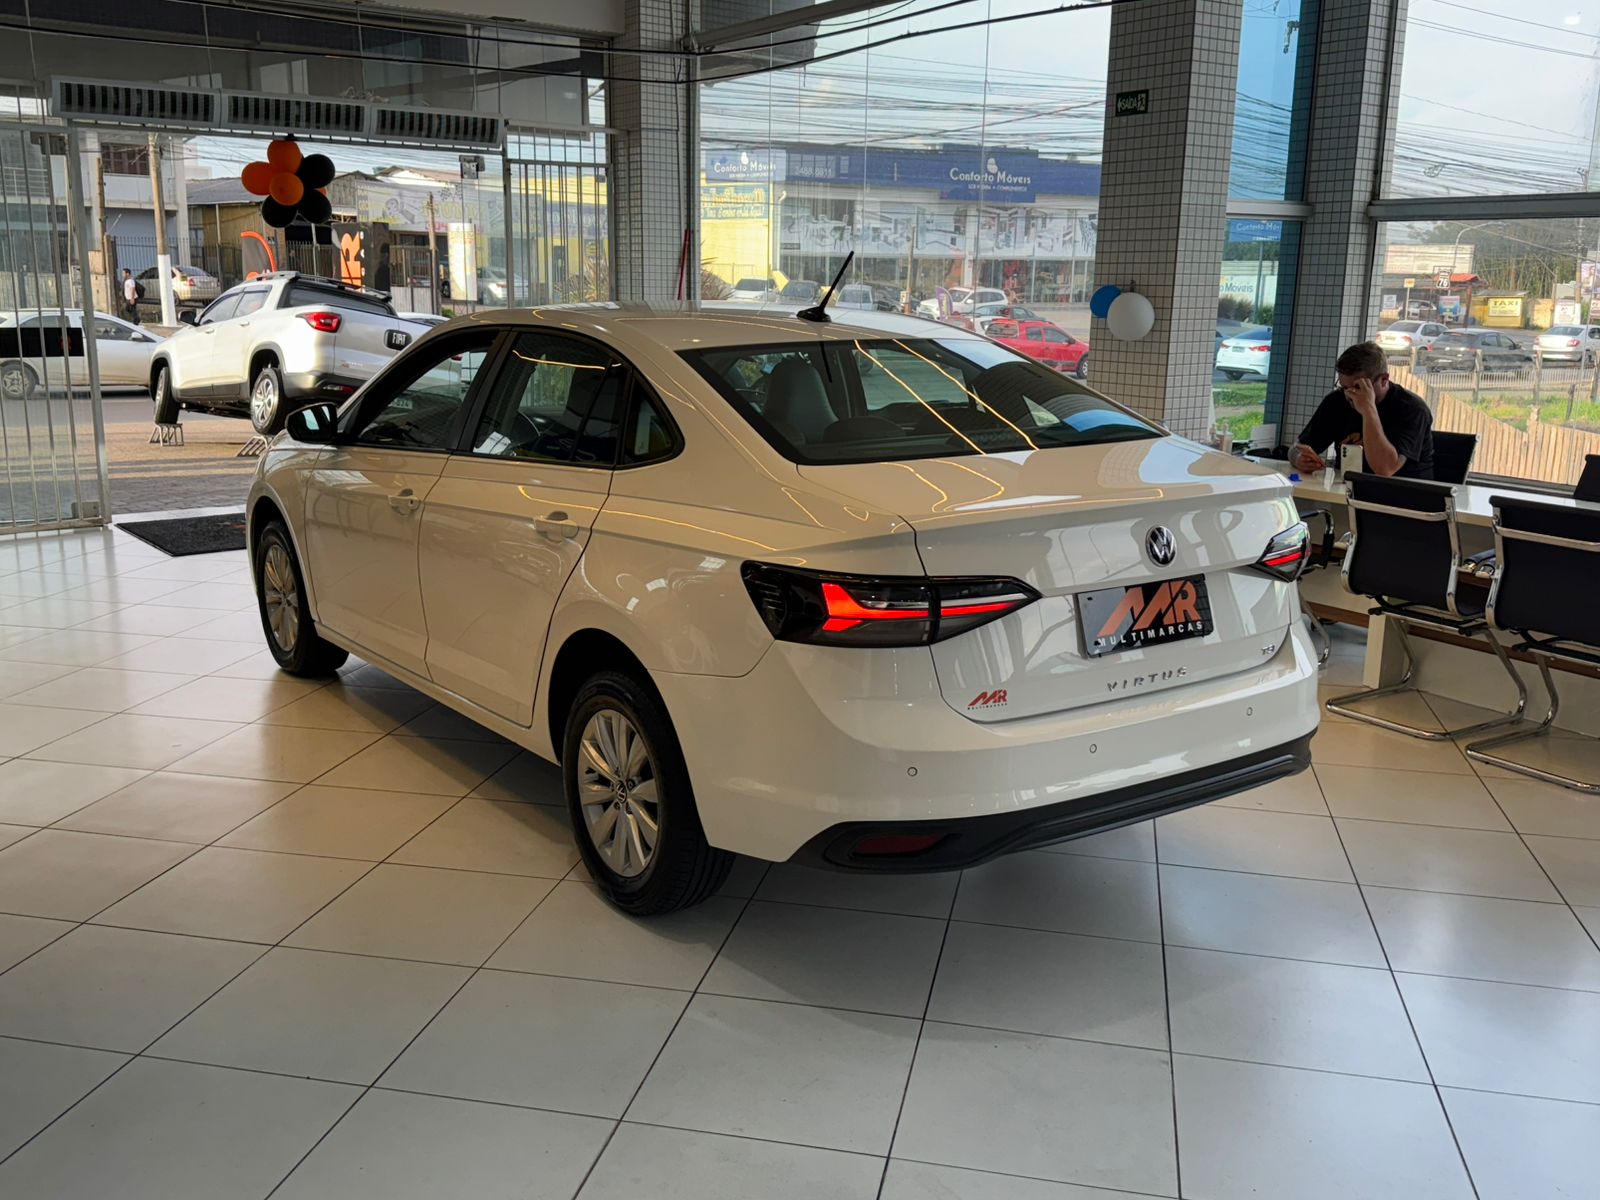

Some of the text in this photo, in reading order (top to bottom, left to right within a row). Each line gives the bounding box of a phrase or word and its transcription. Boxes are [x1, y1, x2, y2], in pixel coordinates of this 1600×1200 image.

[949, 167, 1031, 184] Conforto Móveis
[392, 333, 406, 346] FIAT
[1097, 621, 1203, 647] MULTIMARCAS
[1106, 667, 1187, 692] VIRTUS
